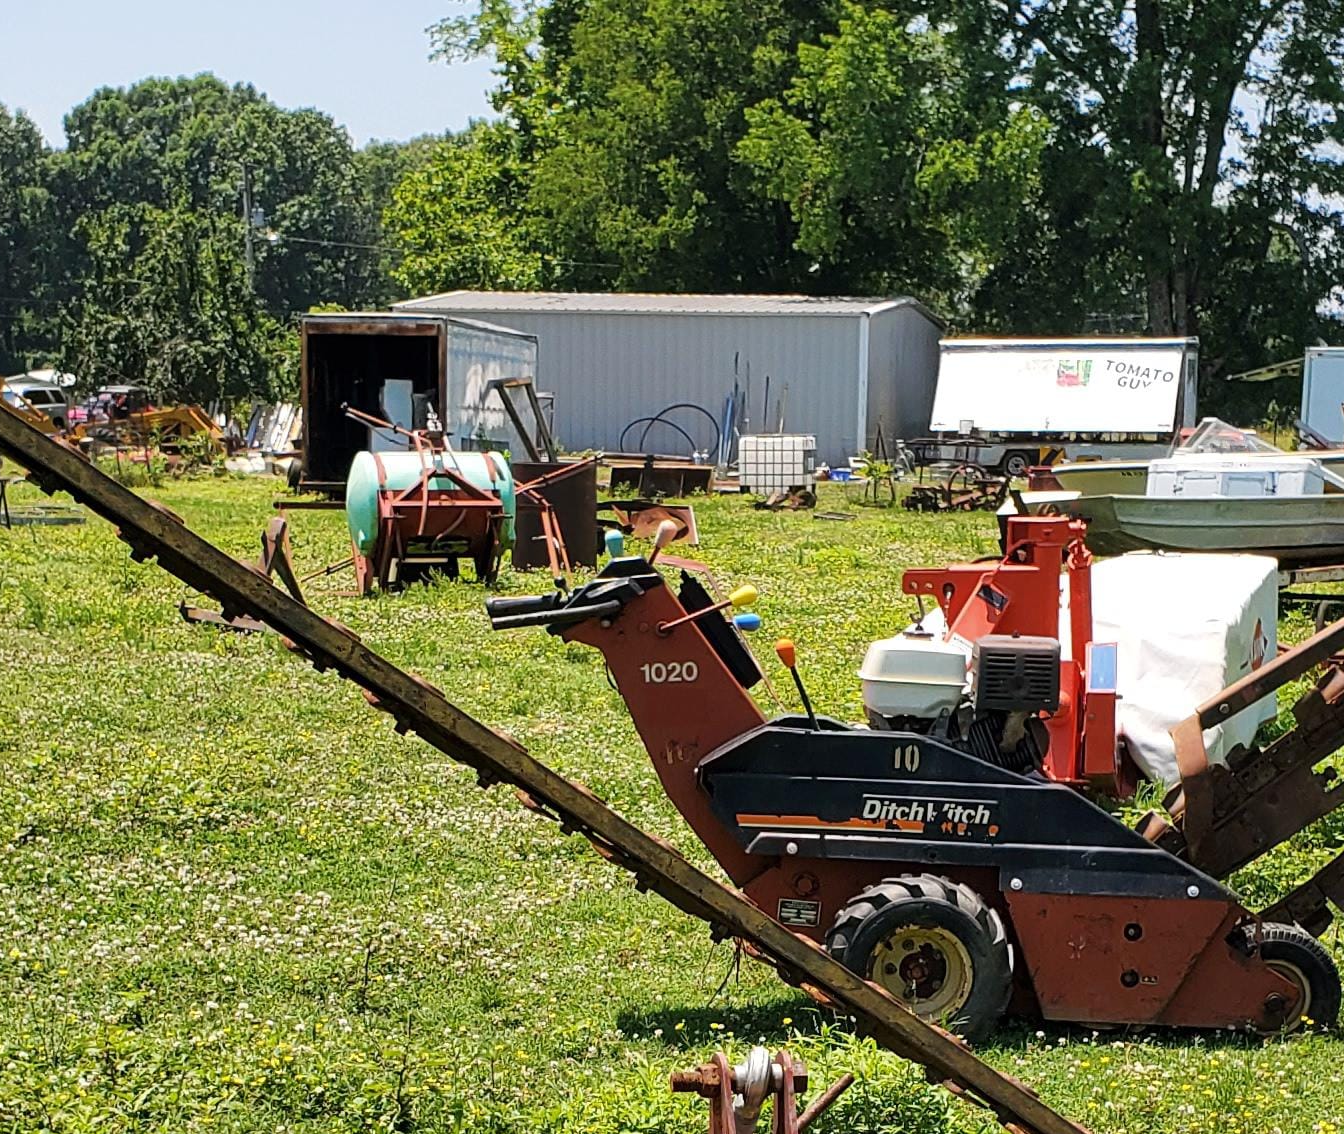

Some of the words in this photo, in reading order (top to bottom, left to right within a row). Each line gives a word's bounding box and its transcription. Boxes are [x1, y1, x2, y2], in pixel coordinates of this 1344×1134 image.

[1106, 360, 1174, 382] TOMATO
[1117, 376, 1152, 389] GUY
[640, 662, 698, 683] 1020
[894, 744, 920, 773] 10
[863, 800, 924, 821] Ditch
